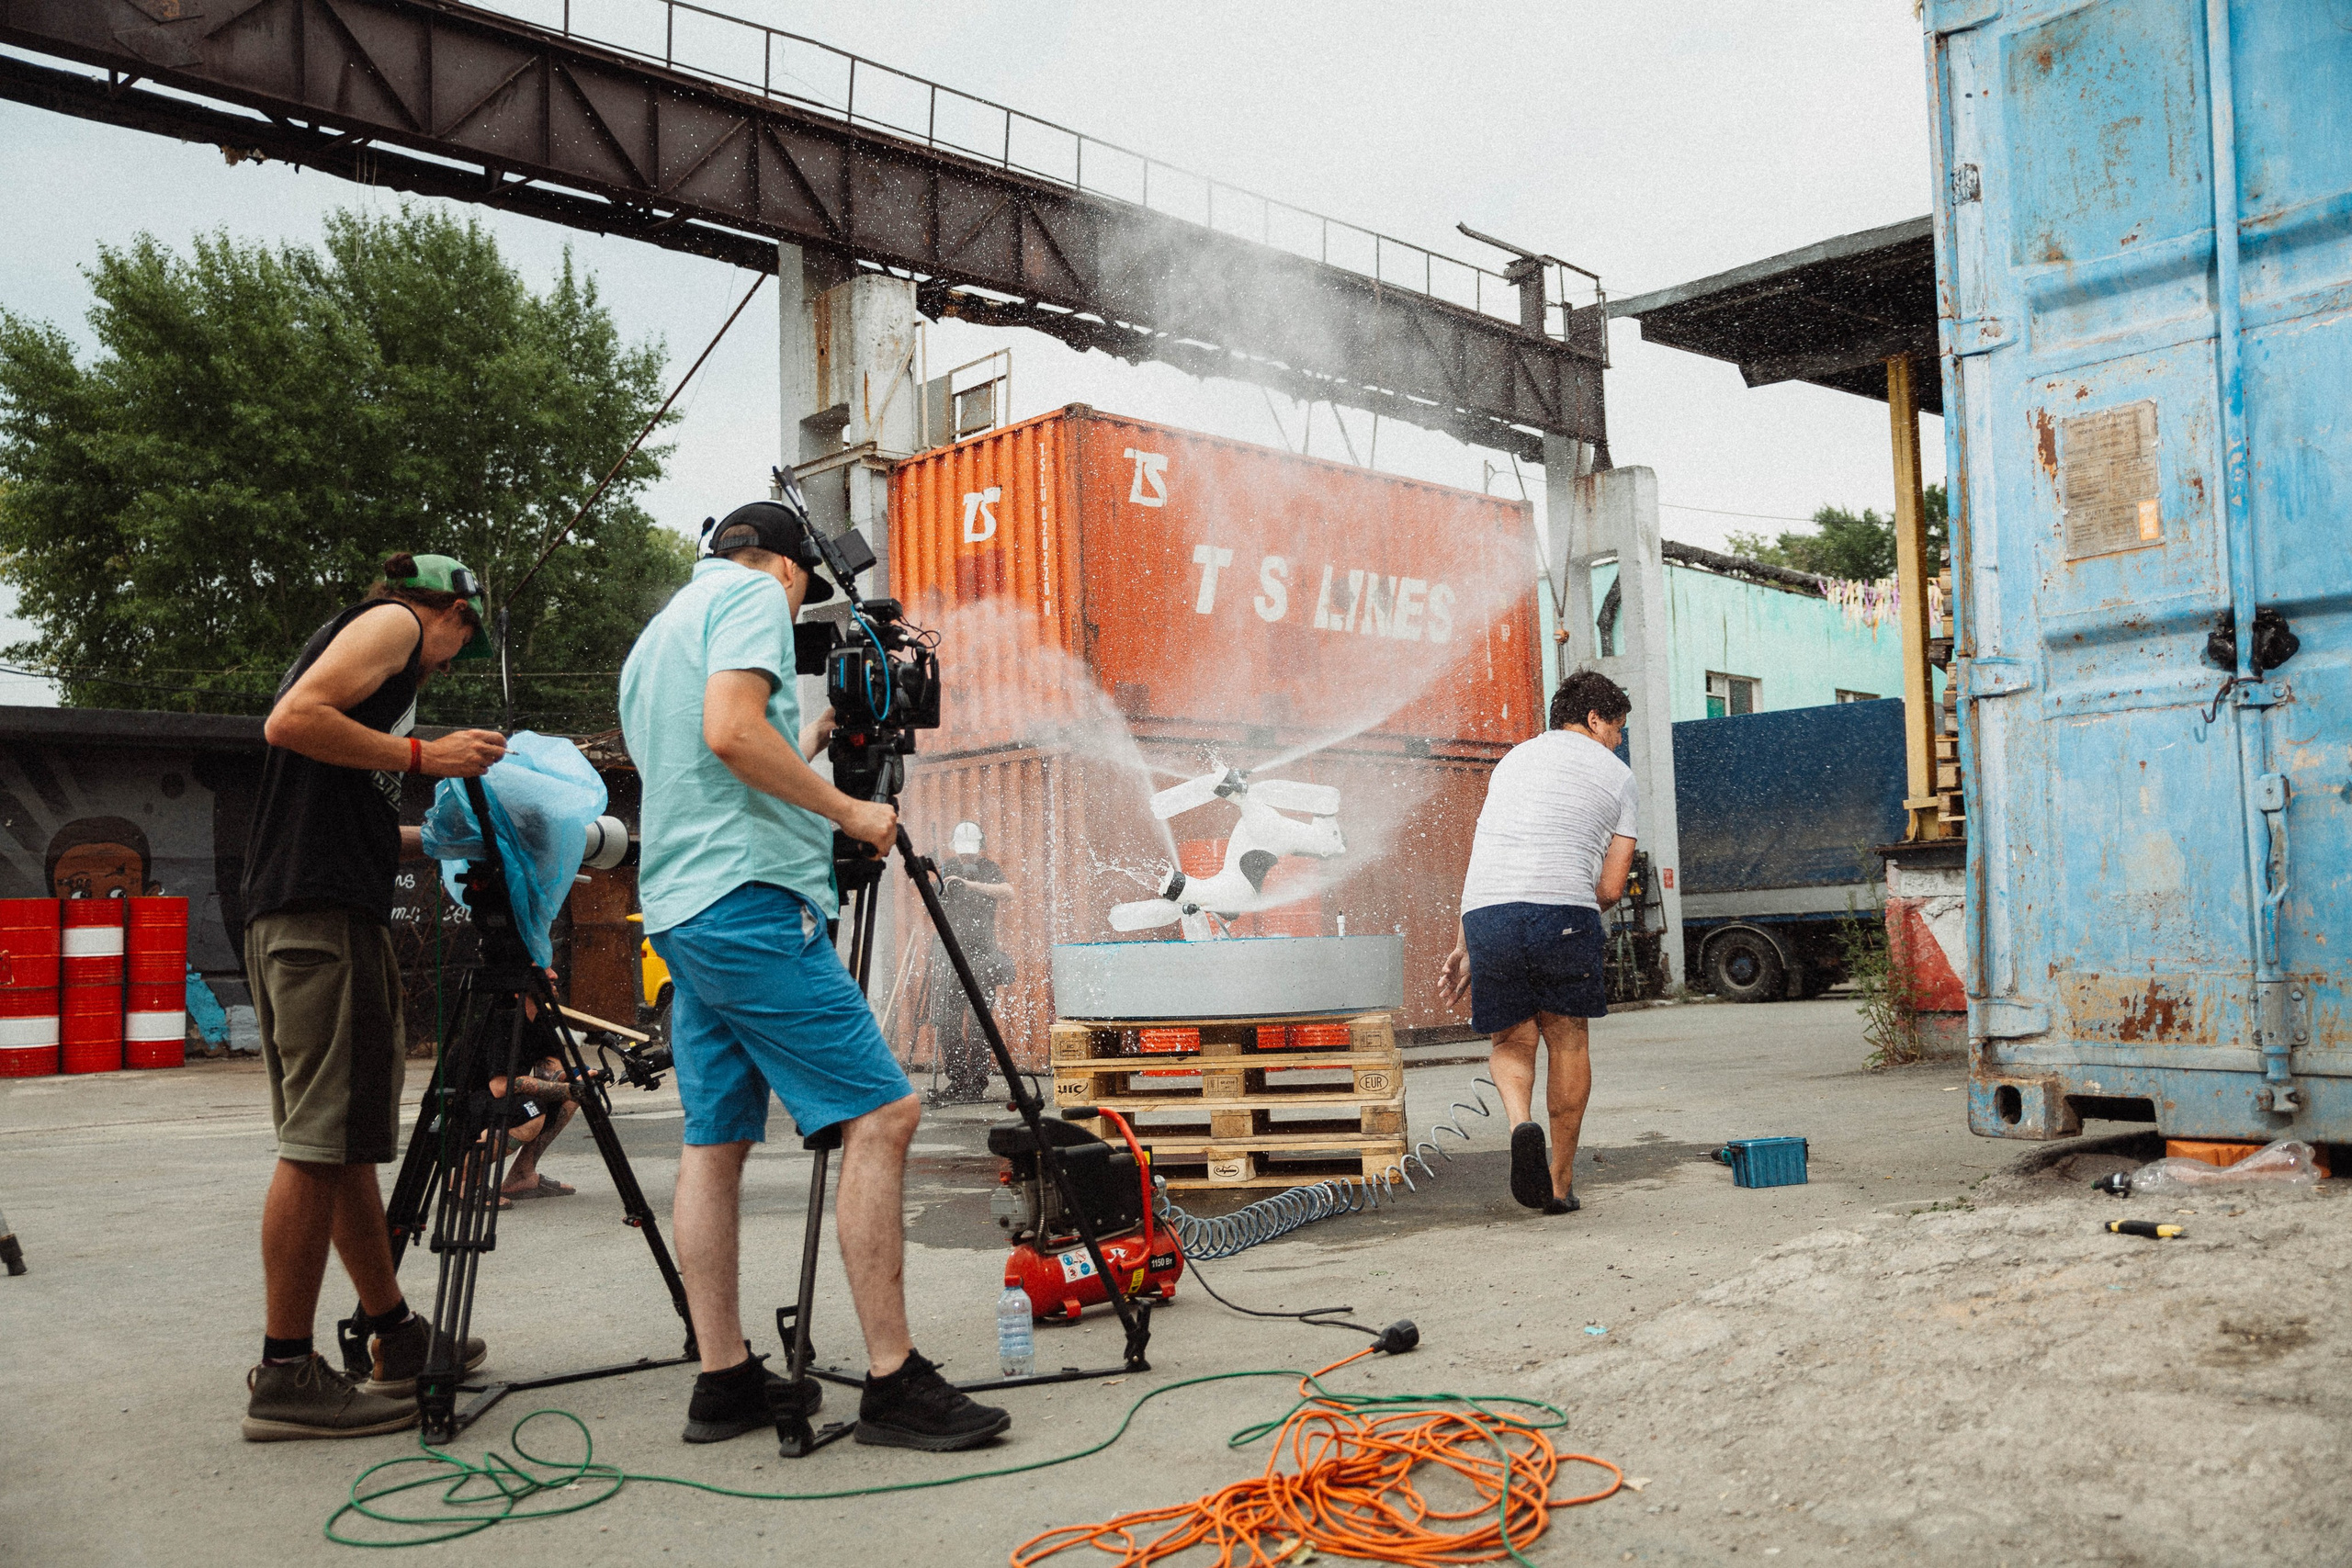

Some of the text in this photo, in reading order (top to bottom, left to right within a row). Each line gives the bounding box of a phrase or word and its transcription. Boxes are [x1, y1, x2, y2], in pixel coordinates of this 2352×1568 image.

[1193, 545, 1456, 643] T S LINES
[1364, 1077, 1383, 1089] EUR
[1151, 1258, 1165, 1268] 1150
